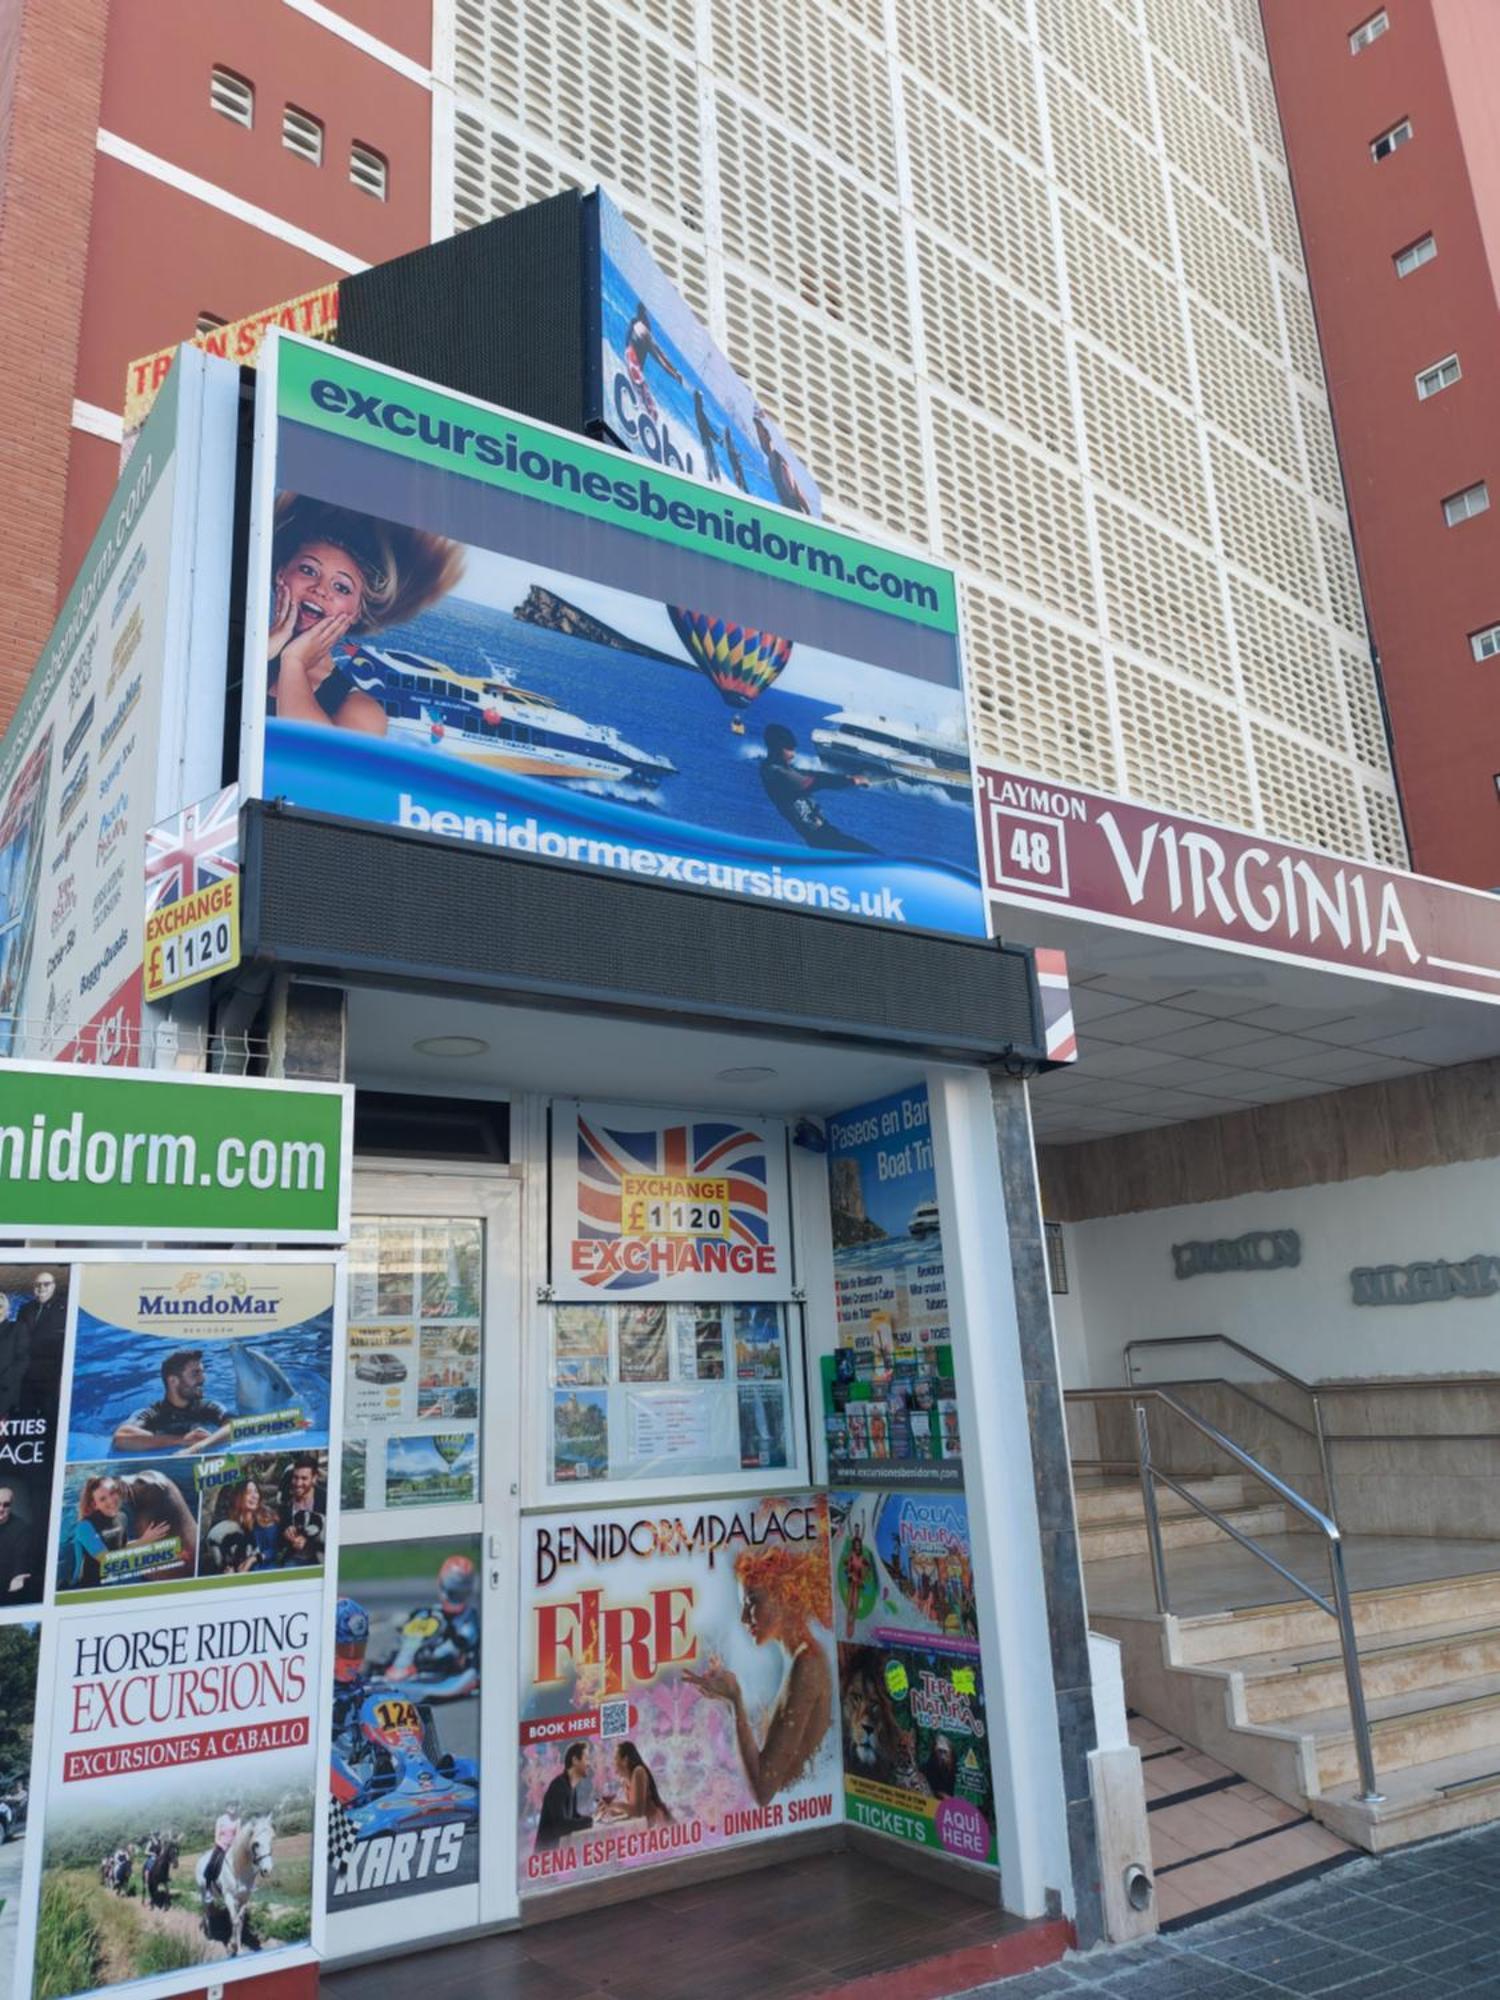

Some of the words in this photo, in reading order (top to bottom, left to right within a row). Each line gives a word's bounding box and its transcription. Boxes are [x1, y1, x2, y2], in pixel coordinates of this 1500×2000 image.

[133, 335, 227, 395] TRN
[311, 377, 938, 612] excursionesbenidorm.com
[398, 793, 906, 922] benidormexcursions.uk
[1010, 828, 1052, 875] 48
[146, 883, 232, 942] EXCHANGE
[1097, 811, 1421, 965] VIRGINIA
[0, 1111, 326, 1191] nidorm.com
[831, 1118, 879, 1152] Paseos
[881, 1110, 899, 1137] en
[624, 1179, 725, 1200] EXCHANGE
[877, 1147, 913, 1182] Boat
[571, 1239, 777, 1274] EXCHANGE
[138, 1295, 281, 1316] MundoMar
[198, 1457, 226, 1476] VIP
[73, 1626, 189, 1678] HORSE
[196, 1612, 309, 1662] RIDING
[532, 1587, 698, 1696] FIRE
[69, 1655, 306, 1734] EXCURSIONS
[69, 1738, 201, 1778] EXCURSIONES
[204, 1740, 218, 1757] A
[222, 1722, 305, 1754] CABALLO
[529, 1724, 565, 1739] BOOK
[568, 1716, 597, 1731] HERE
[528, 1844, 577, 1878] CENA
[583, 1821, 702, 1867] ESPECTACULO
[724, 1807, 784, 1836] DINNER
[788, 1793, 833, 1824] SHOW
[855, 1803, 926, 1842] TICKETS
[943, 1827, 984, 1854] HERE
